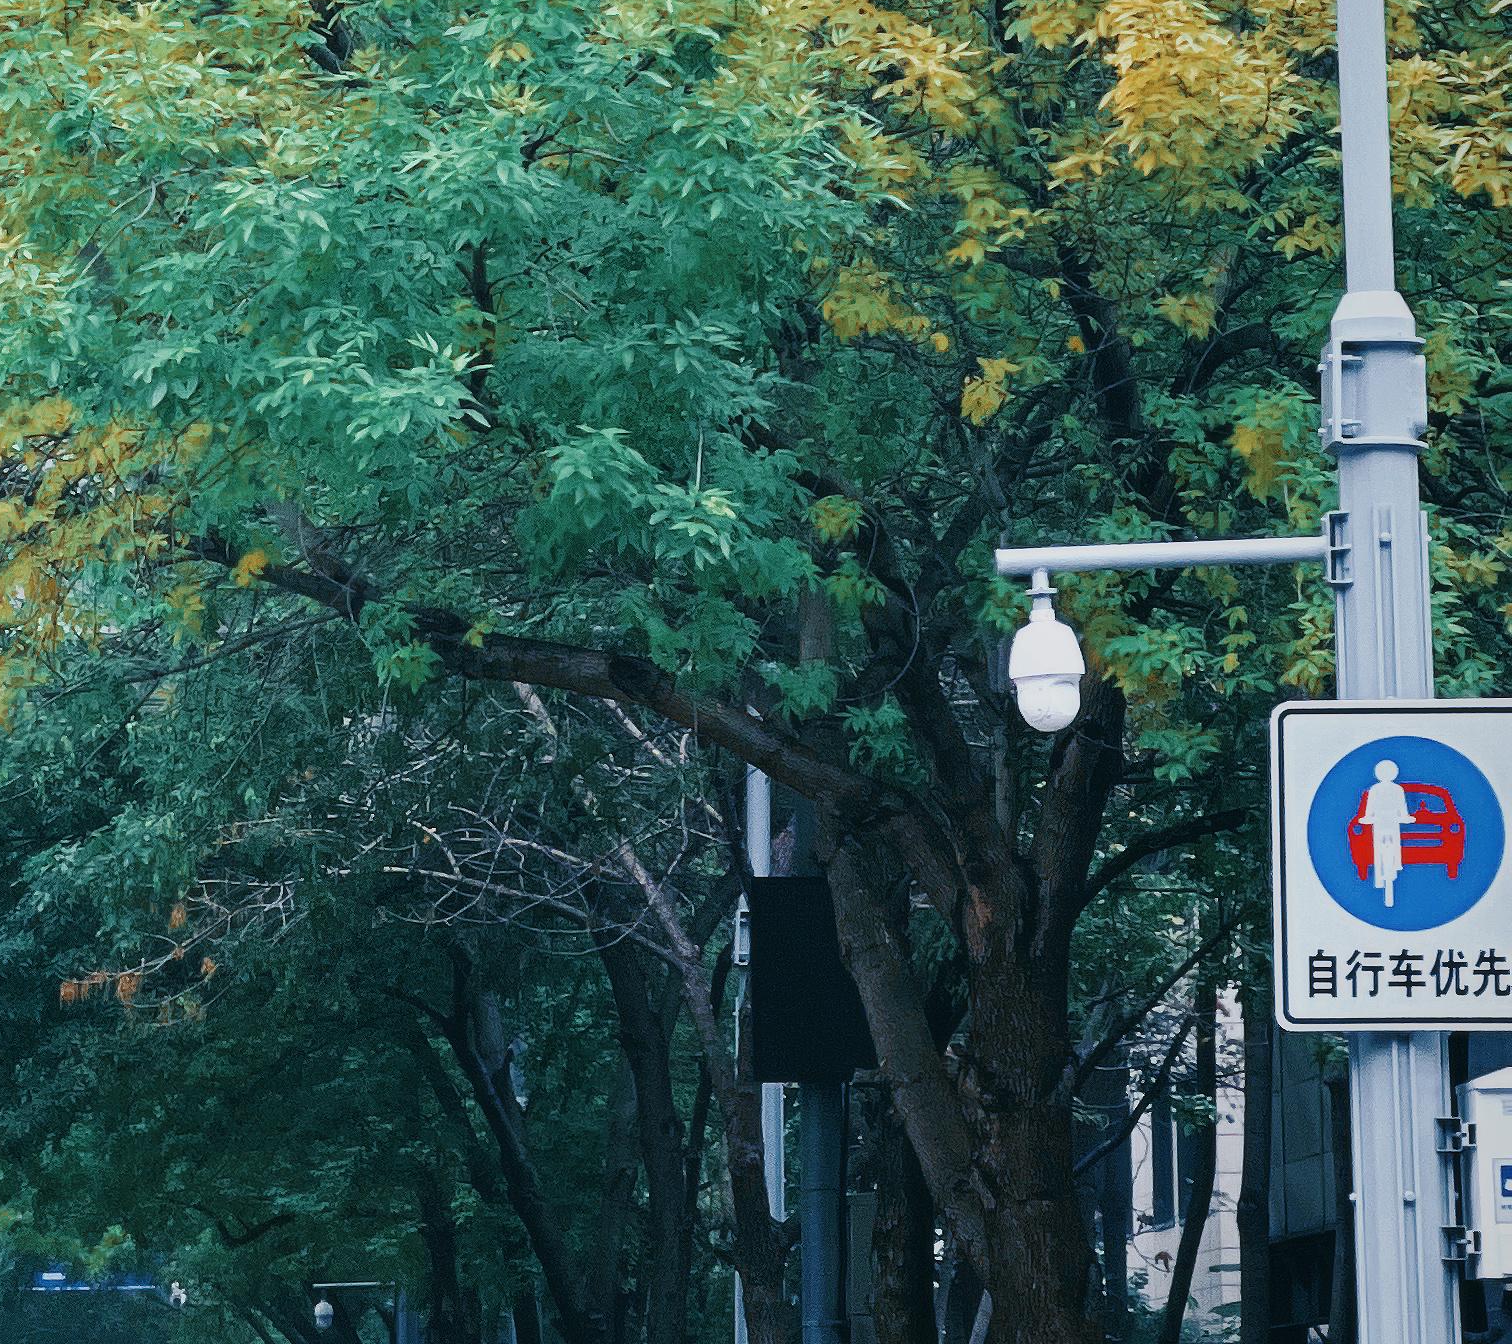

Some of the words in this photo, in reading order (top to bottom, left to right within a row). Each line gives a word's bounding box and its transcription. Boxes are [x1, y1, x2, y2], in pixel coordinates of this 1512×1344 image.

[1308, 948, 1511, 998] 自行车优先
